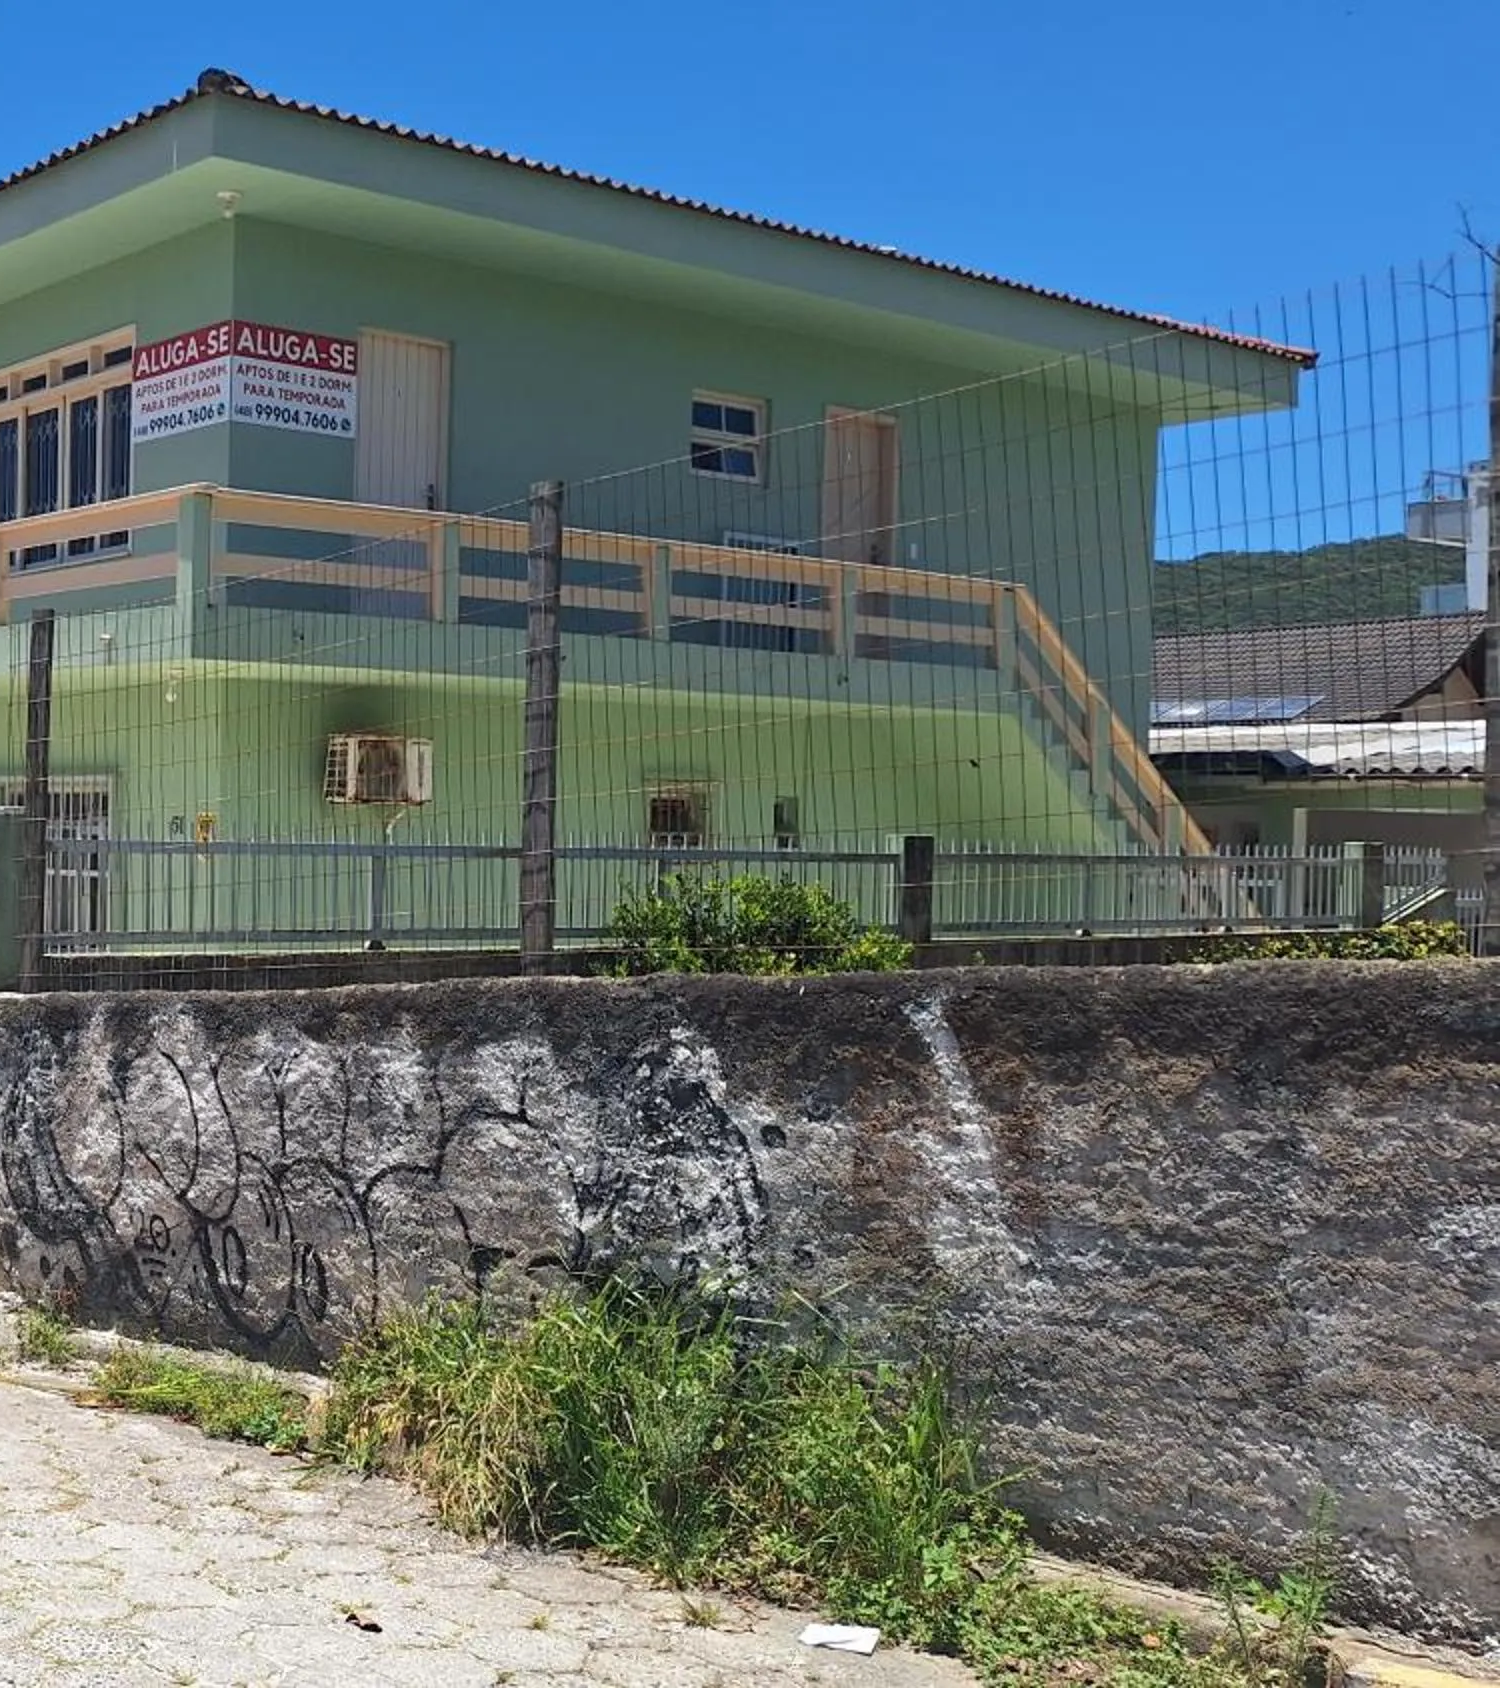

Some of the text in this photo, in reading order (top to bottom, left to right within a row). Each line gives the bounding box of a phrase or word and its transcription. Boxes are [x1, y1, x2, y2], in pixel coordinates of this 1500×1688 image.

[136, 325, 229, 377] ALUGA-SE
[237, 327, 355, 371] ALUGA-SE
[136, 383, 164, 398] APTOS
[166, 377, 177, 390] DE
[237, 364, 275, 380] APTOS
[277, 370, 290, 383] DE
[301, 374, 307, 386] E
[310, 376, 316, 388] 2
[142, 383, 220, 413] PARA TEMPORADA
[243, 383, 346, 410] PARA TEMPORADA
[150, 404, 214, 433] 99904.7606
[255, 404, 338, 431] 99904.7606
